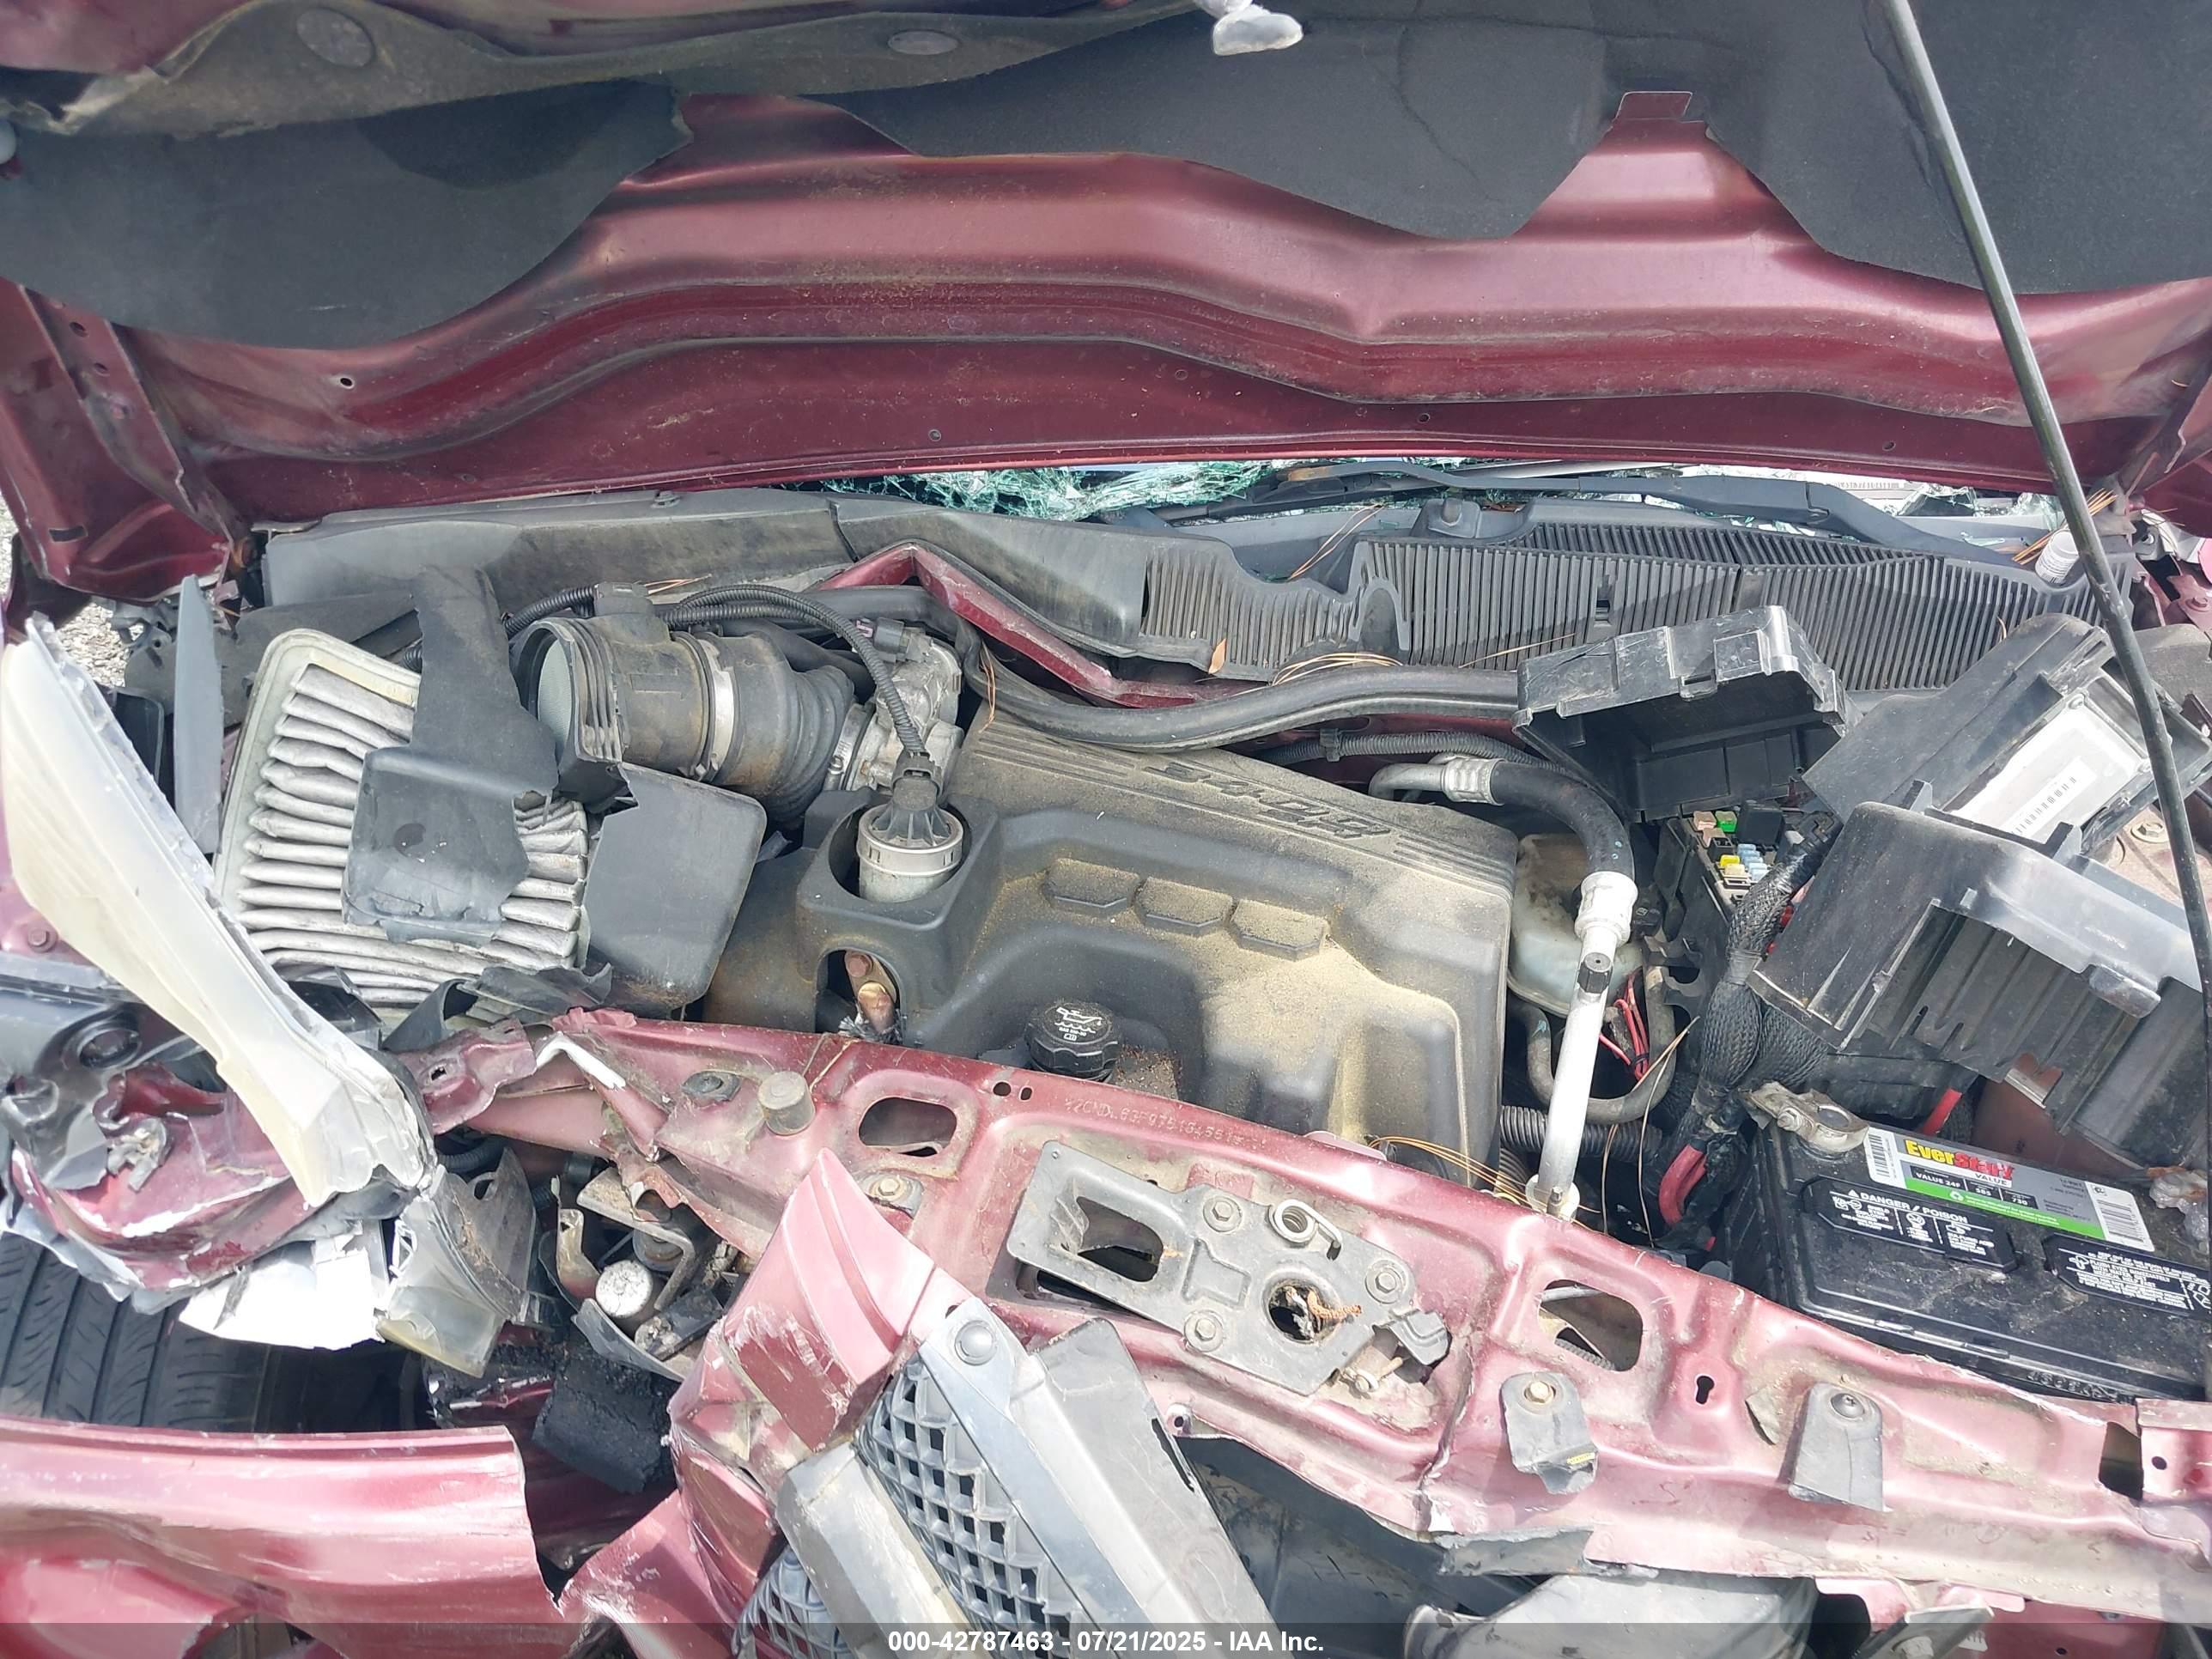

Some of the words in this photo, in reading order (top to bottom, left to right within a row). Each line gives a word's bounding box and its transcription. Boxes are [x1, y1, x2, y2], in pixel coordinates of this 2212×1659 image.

[1905, 1139, 2015, 1180] EverStart
[1916, 1173, 1944, 1185] VALUE
[1975, 1173, 2008, 1186] VALUE
[1861, 1193, 1911, 1211] DANGER
[1923, 1207, 1968, 1224] POISON
